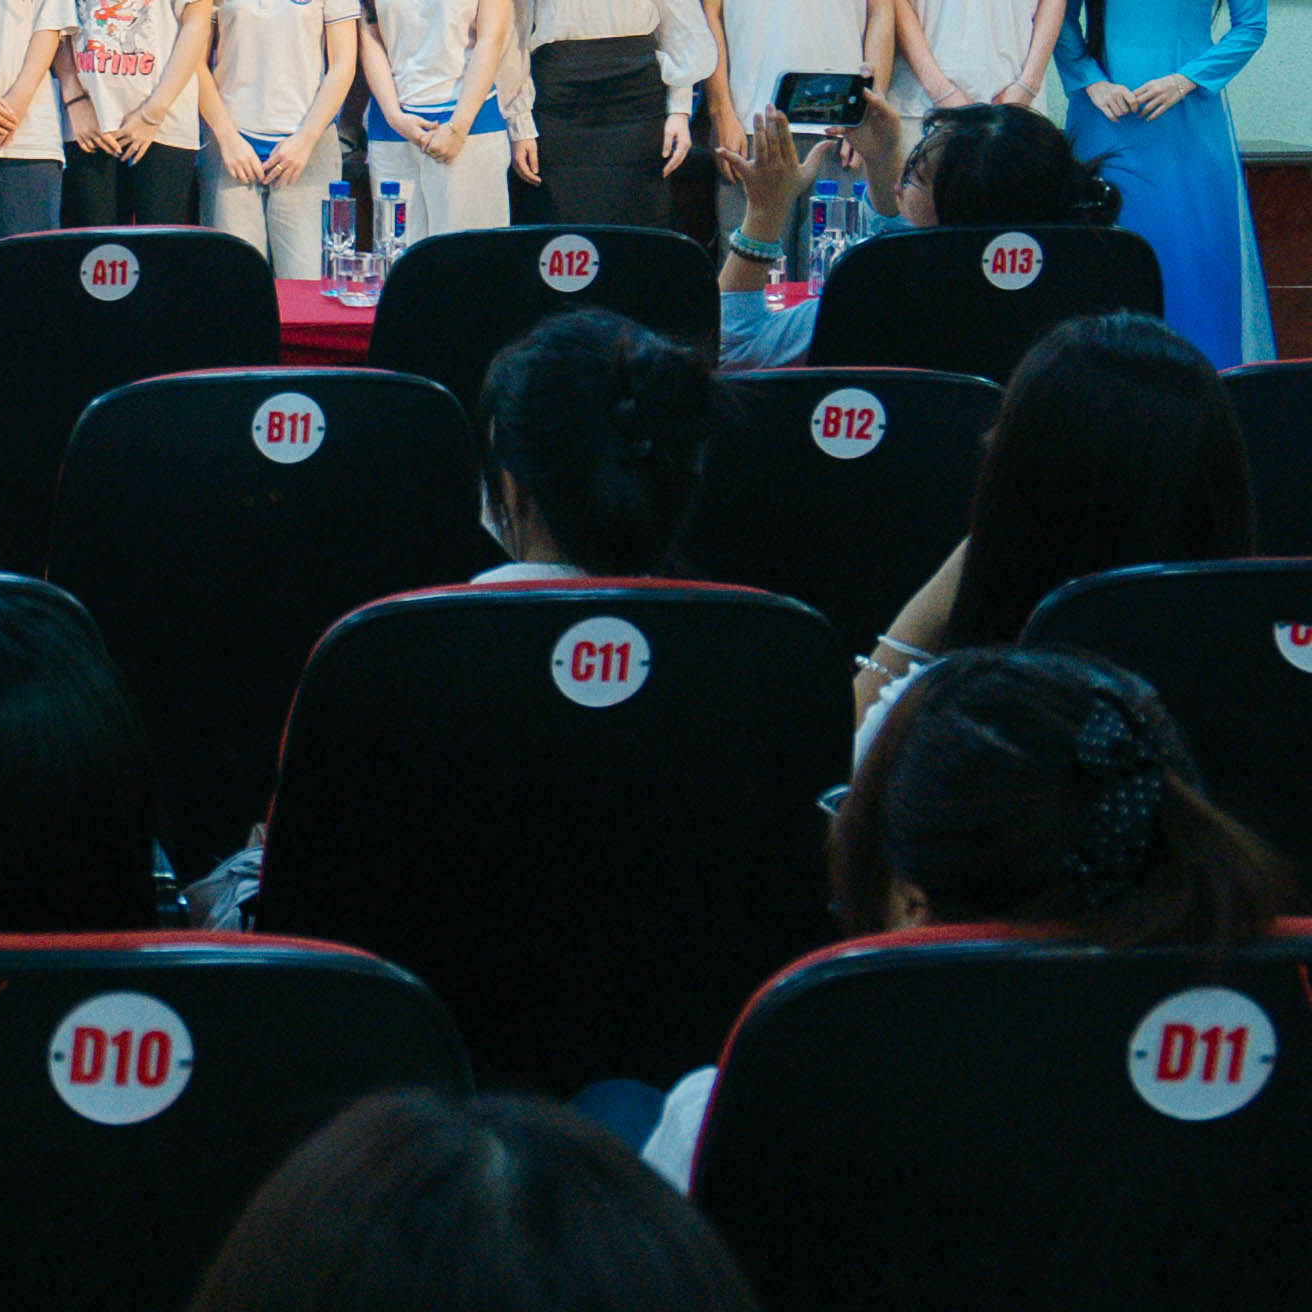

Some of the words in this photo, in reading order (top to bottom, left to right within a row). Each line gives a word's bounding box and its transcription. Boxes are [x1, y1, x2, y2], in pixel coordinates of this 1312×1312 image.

[92, 259, 127, 285] A11
[548, 250, 590, 276] A12
[991, 247, 1033, 273] A13
[267, 411, 311, 443] B11
[822, 406, 874, 440] B12
[571, 641, 630, 681] C11
[70, 1026, 170, 1086] D10
[1157, 1025, 1245, 1082] D11
